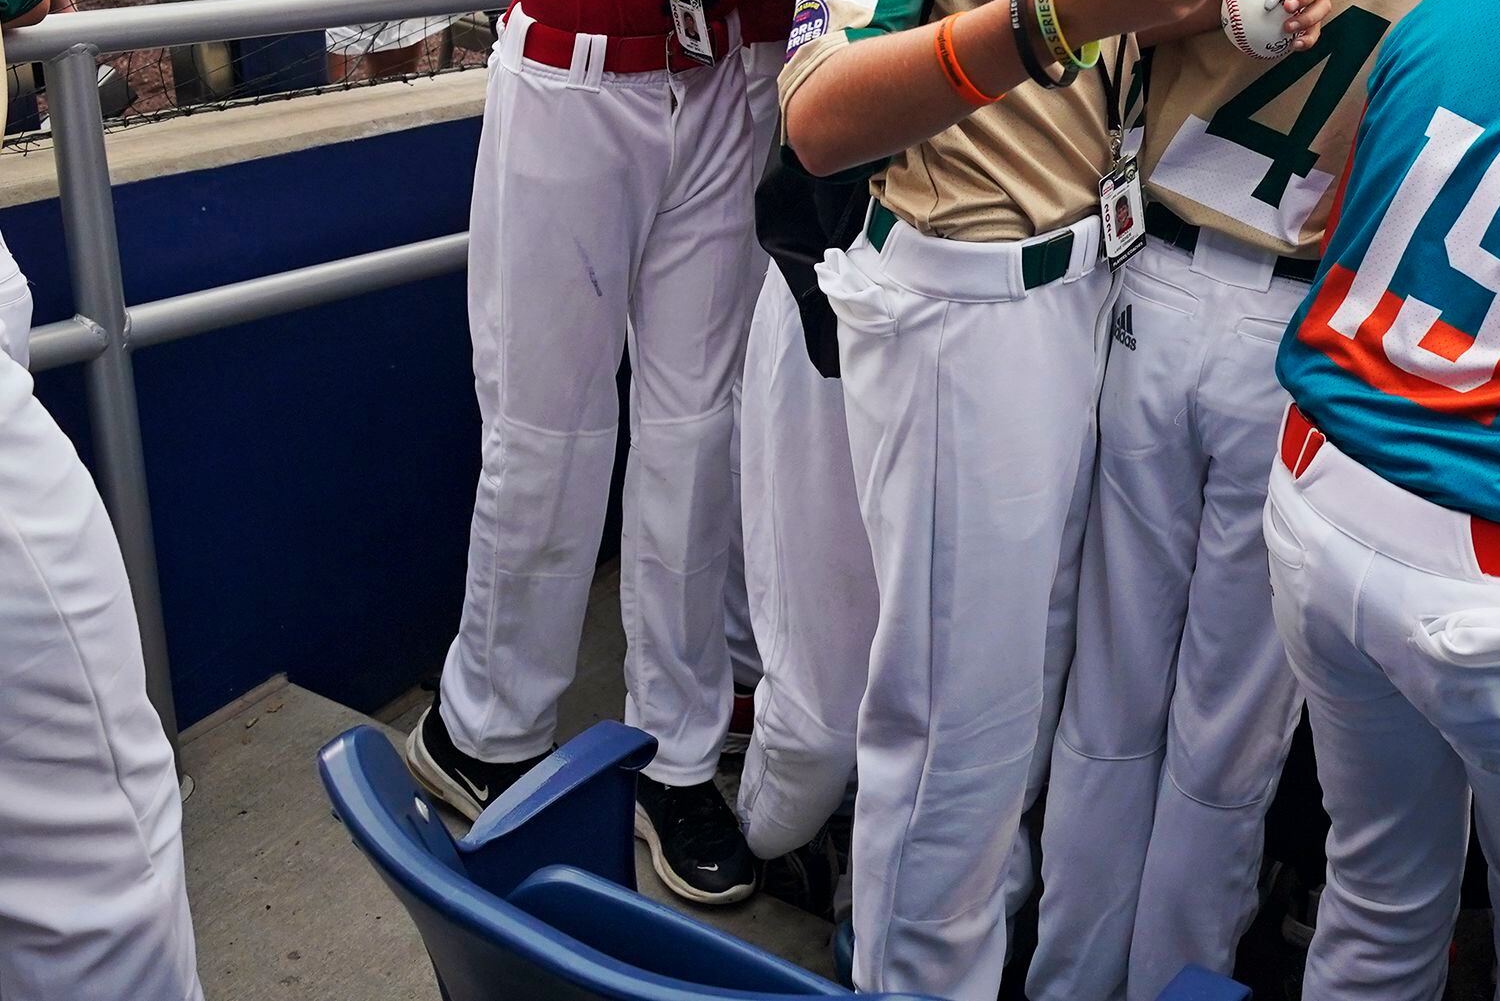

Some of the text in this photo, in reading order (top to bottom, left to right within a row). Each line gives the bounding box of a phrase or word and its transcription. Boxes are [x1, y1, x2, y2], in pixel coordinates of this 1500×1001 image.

[787, 28, 822, 50] ERIES
[790, 18, 823, 39] ORLD
[1204, 4, 1392, 209] 4
